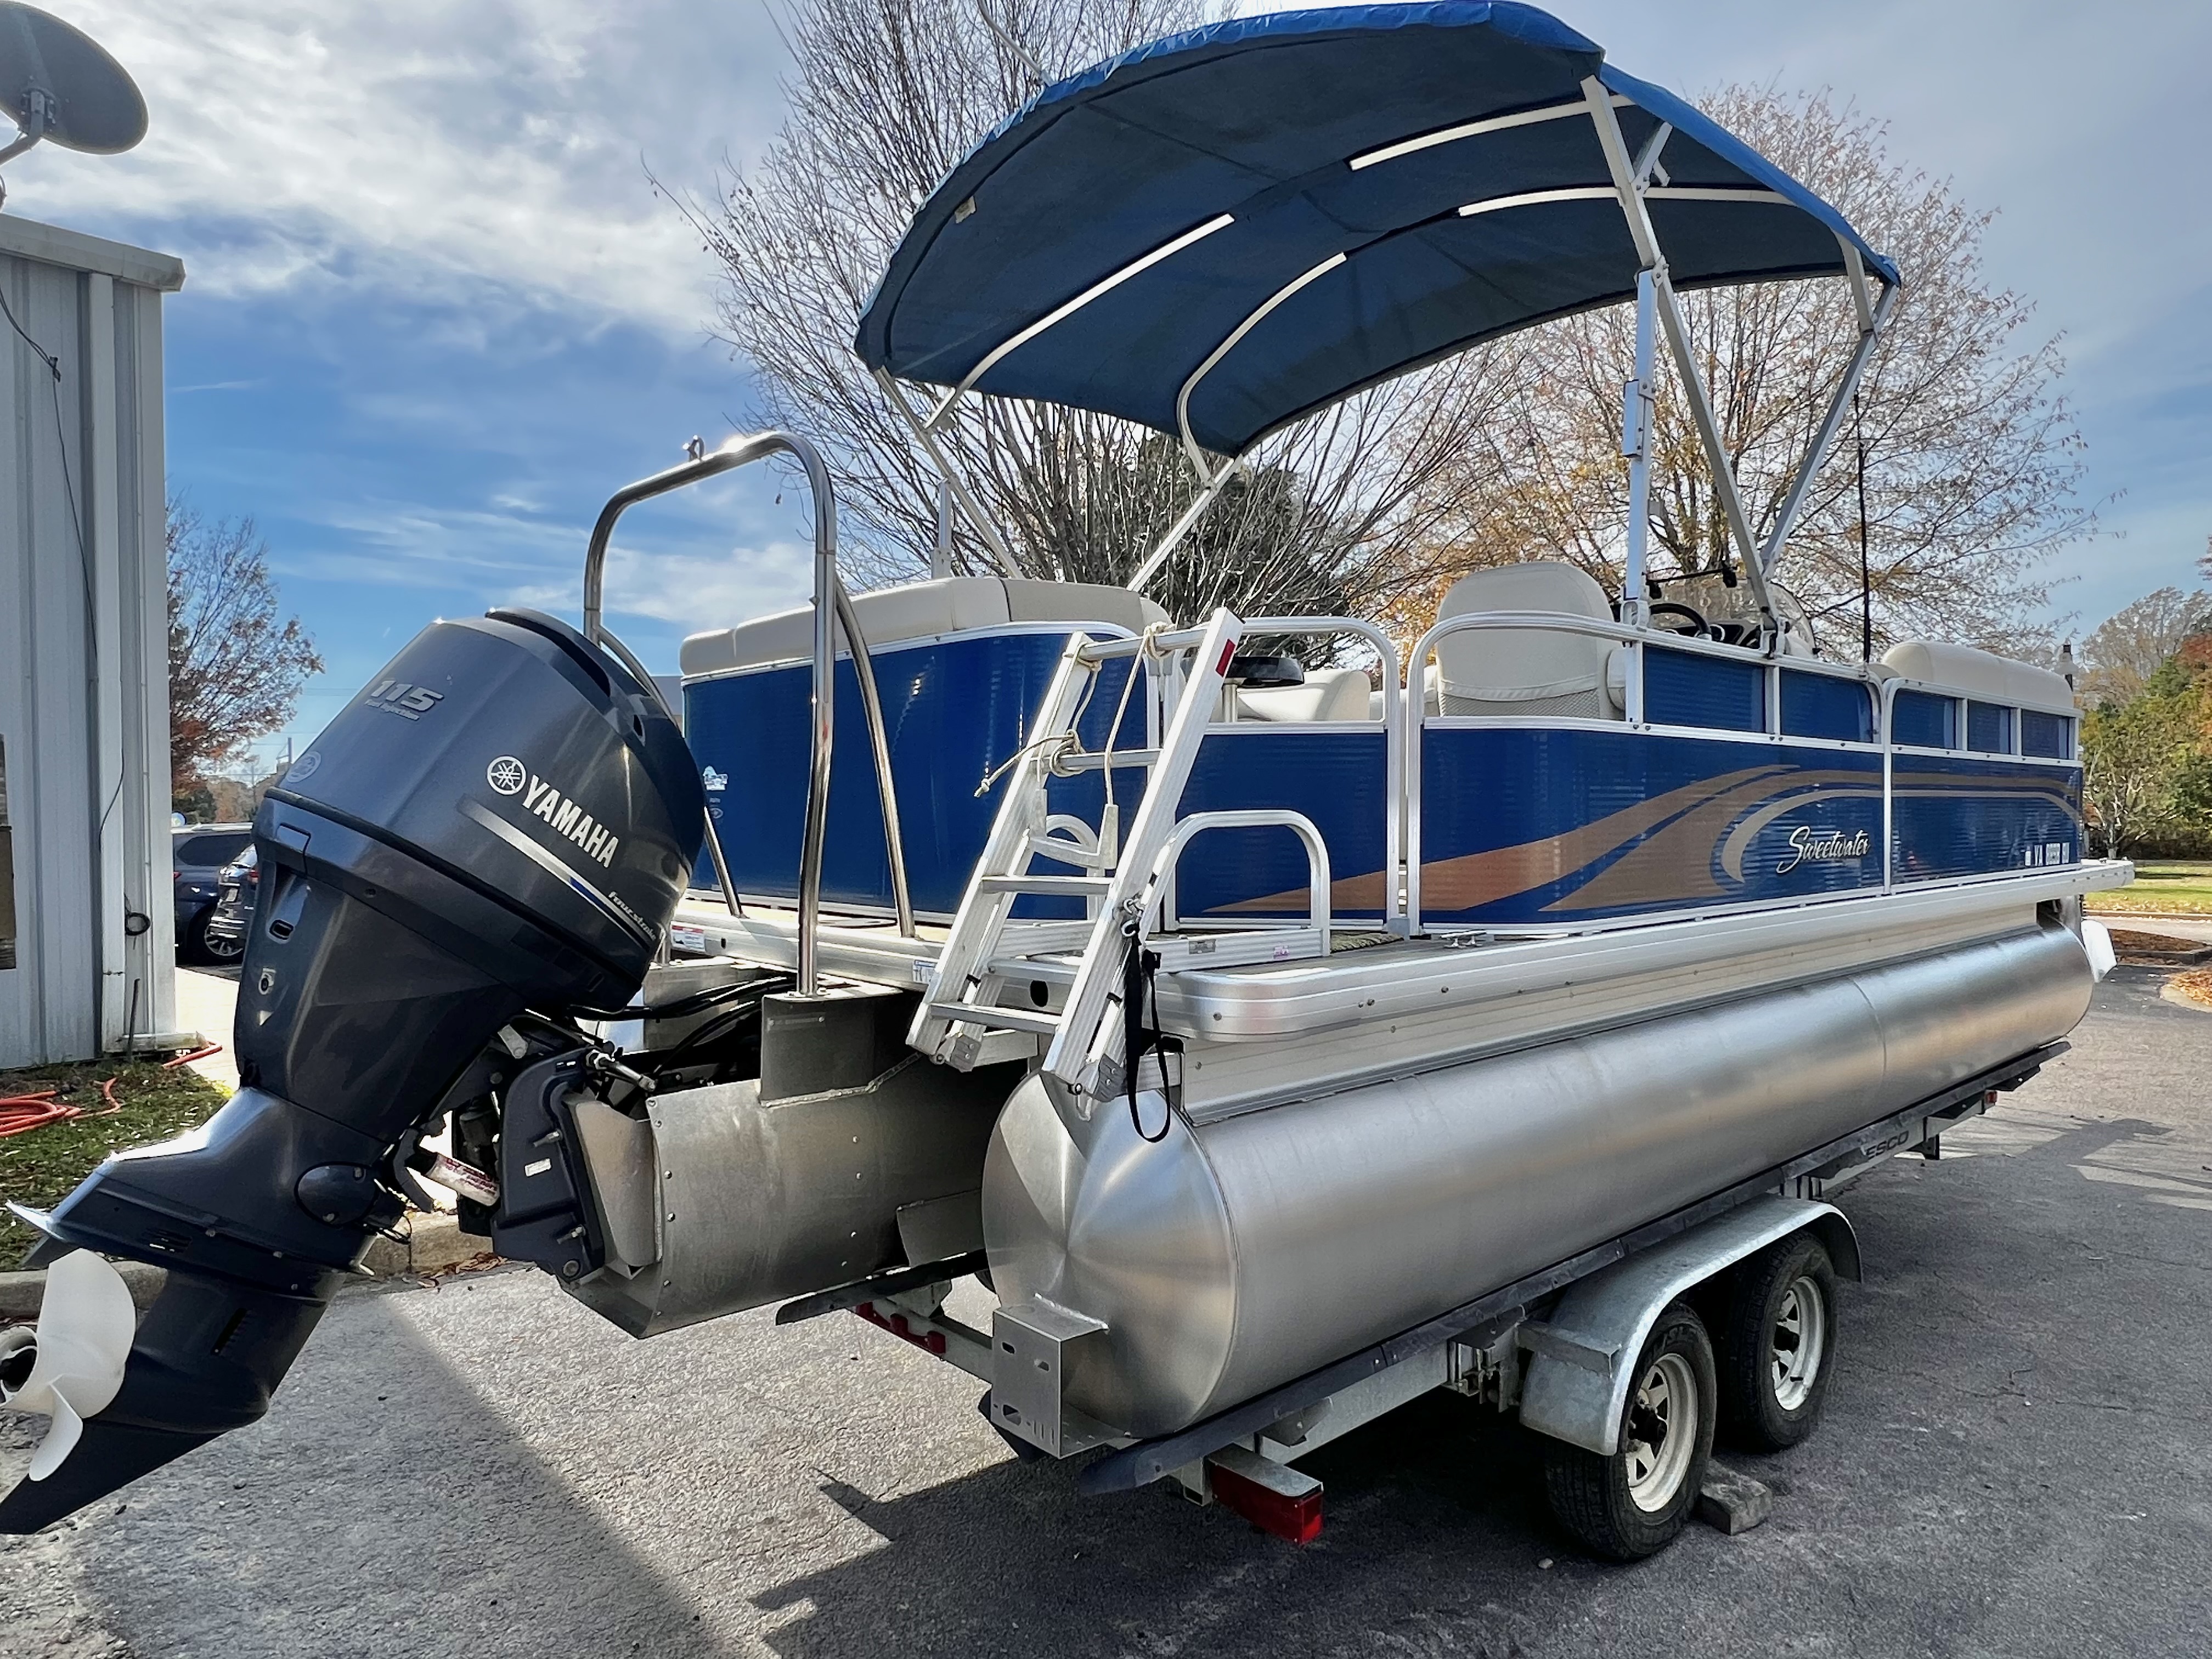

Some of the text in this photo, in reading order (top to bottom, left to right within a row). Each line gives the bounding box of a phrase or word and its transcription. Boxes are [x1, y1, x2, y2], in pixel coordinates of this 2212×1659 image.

[371, 680, 444, 712] 115
[522, 774, 619, 868] YAMAHA
[1775, 825, 1870, 873] Sweetwater
